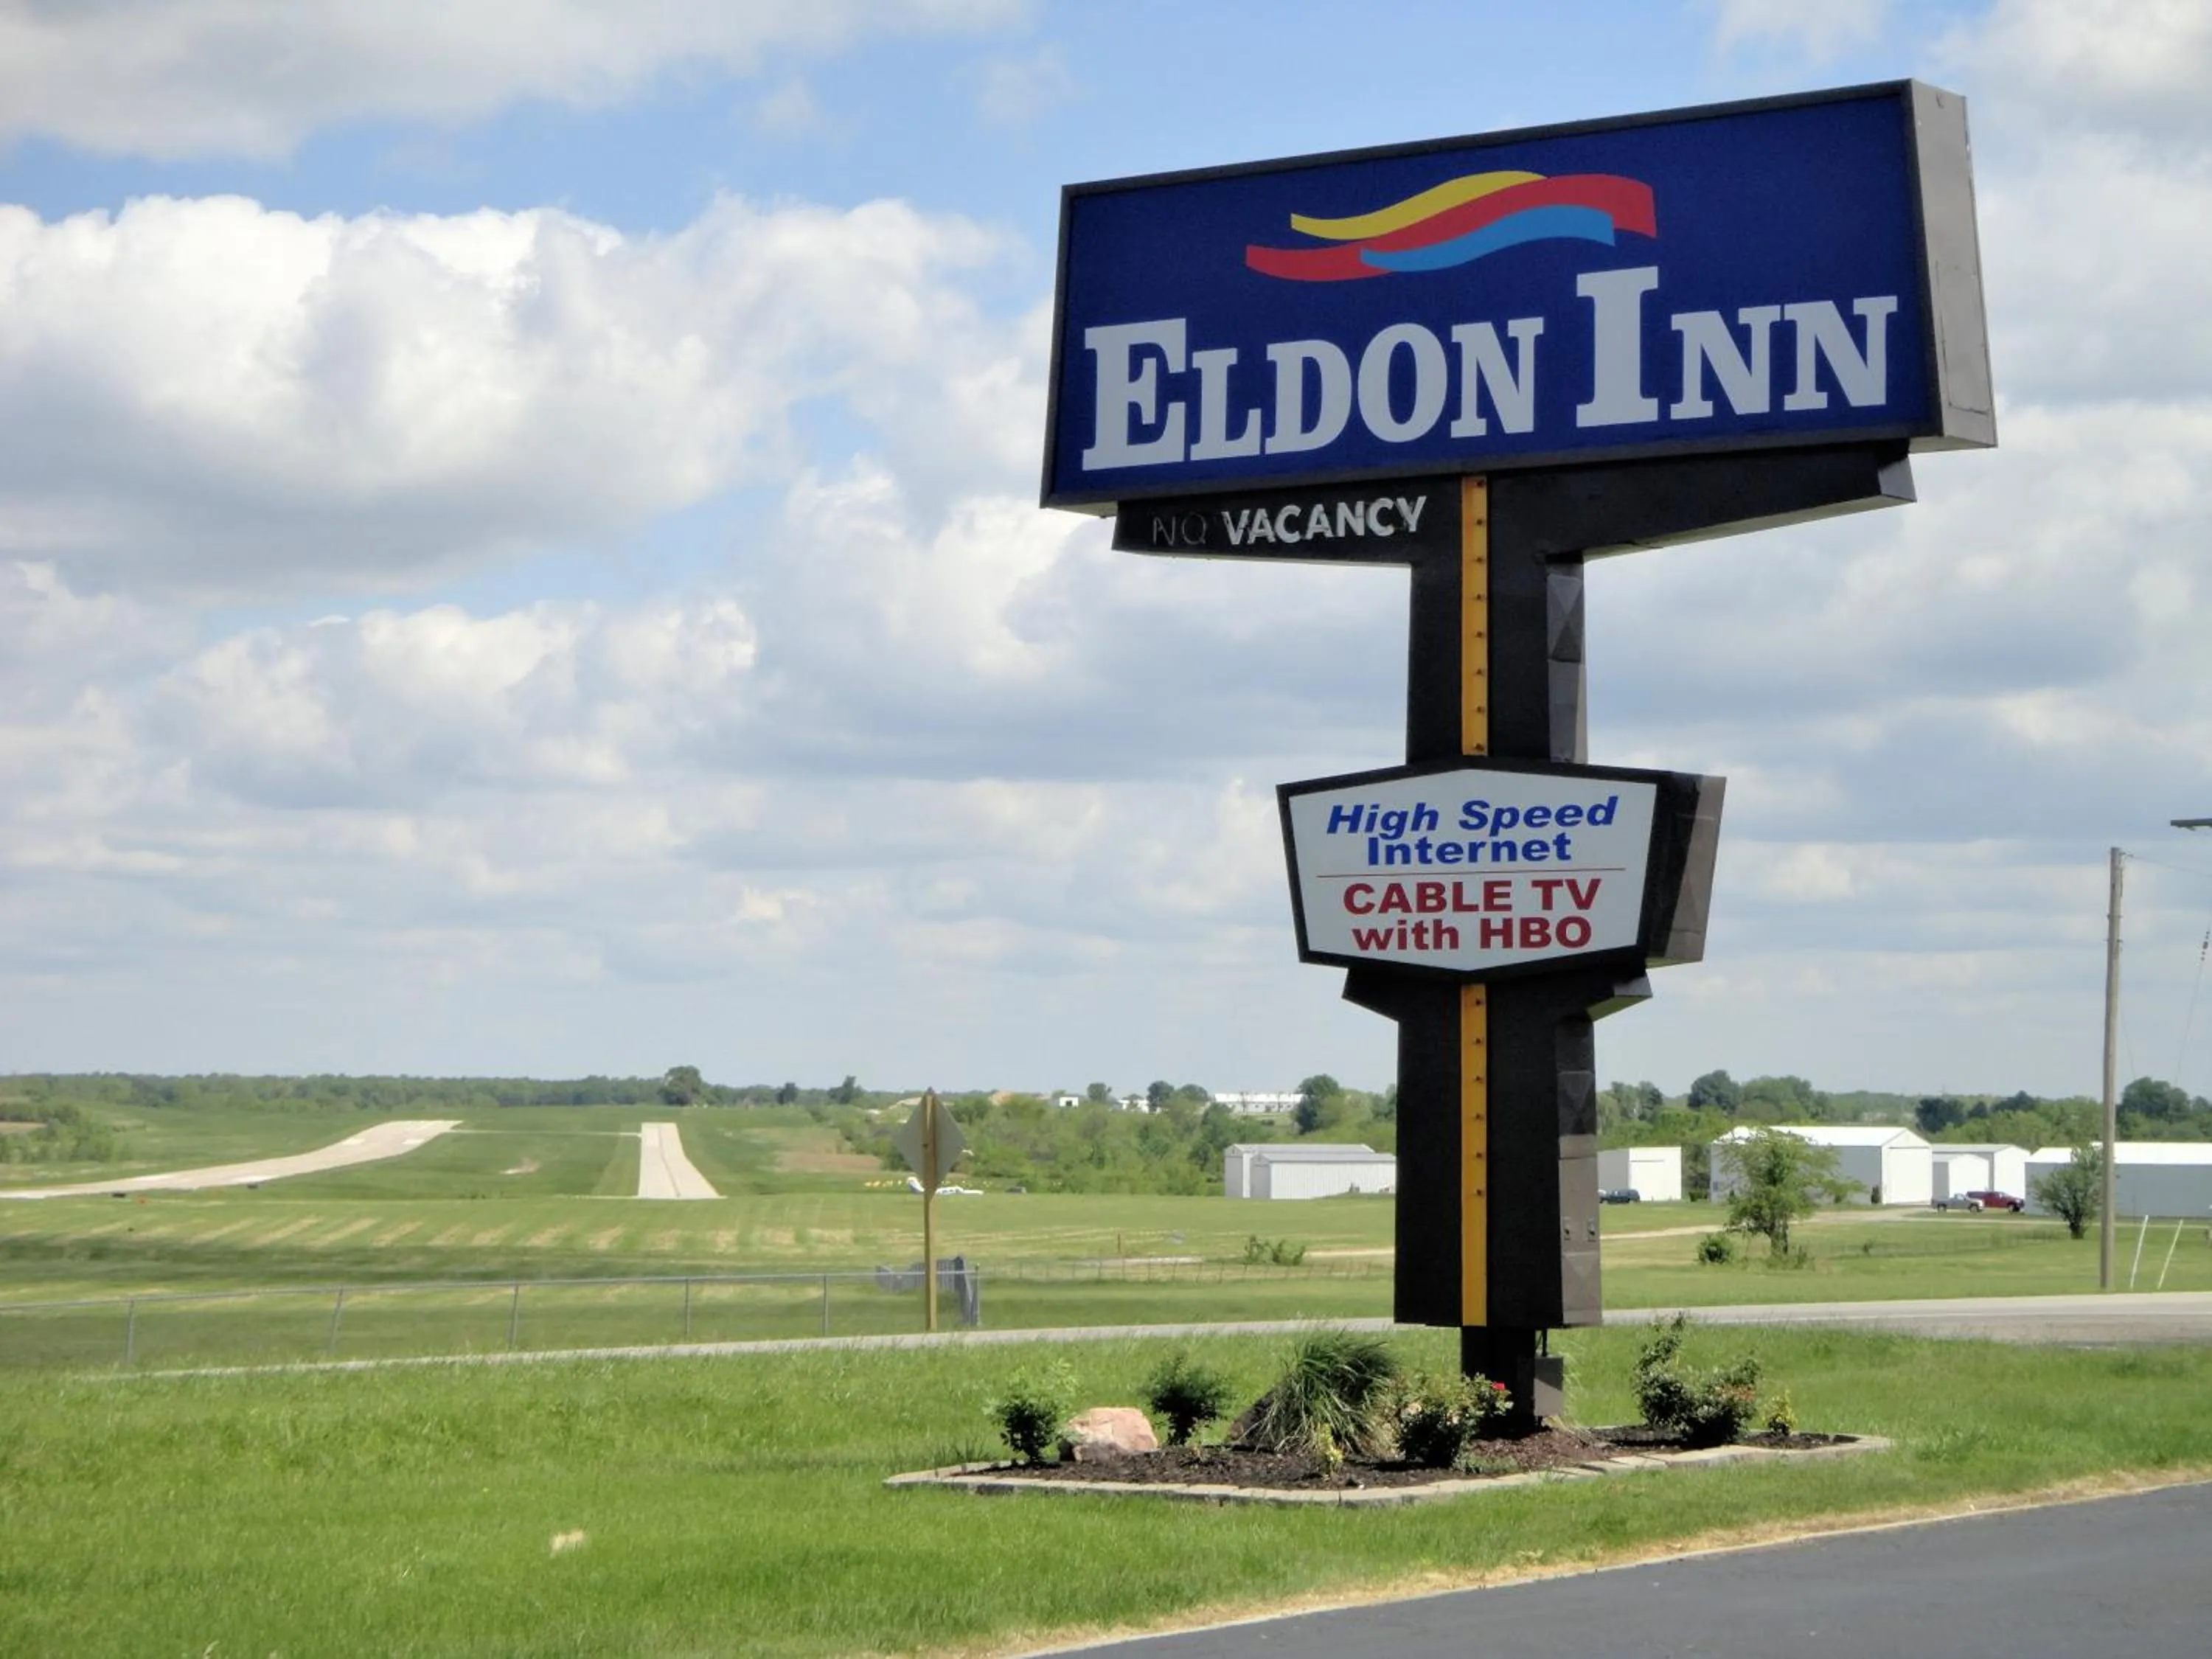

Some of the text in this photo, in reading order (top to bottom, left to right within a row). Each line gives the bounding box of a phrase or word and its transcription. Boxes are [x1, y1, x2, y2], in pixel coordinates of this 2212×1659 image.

[1082, 265, 1898, 472] ELDON INN
[1221, 495, 1427, 546] VACANCY
[1326, 795, 1619, 841] High Speed
[1366, 832, 1572, 866] Internet
[1342, 877, 1602, 916] CABLE TV
[1351, 916, 1593, 951] with HBO
